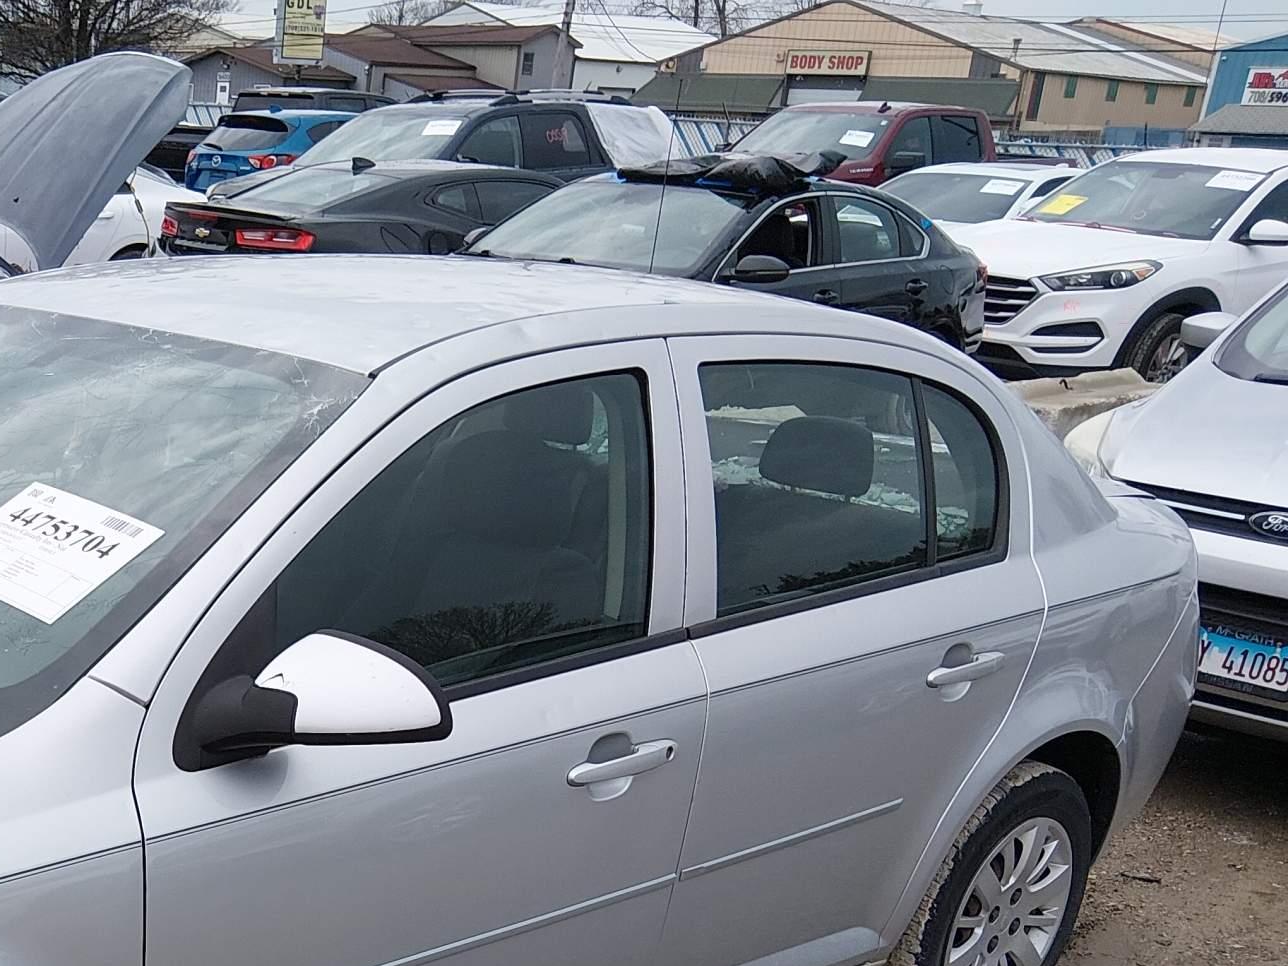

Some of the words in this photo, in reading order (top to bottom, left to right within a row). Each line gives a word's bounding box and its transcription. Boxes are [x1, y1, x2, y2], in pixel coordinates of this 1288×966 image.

[790, 54, 825, 69] BODY
[827, 55, 864, 70] SHOP
[9, 507, 121, 559] 44753704
[1263, 515, 1288, 532] For
[1221, 646, 1288, 686] 41085
